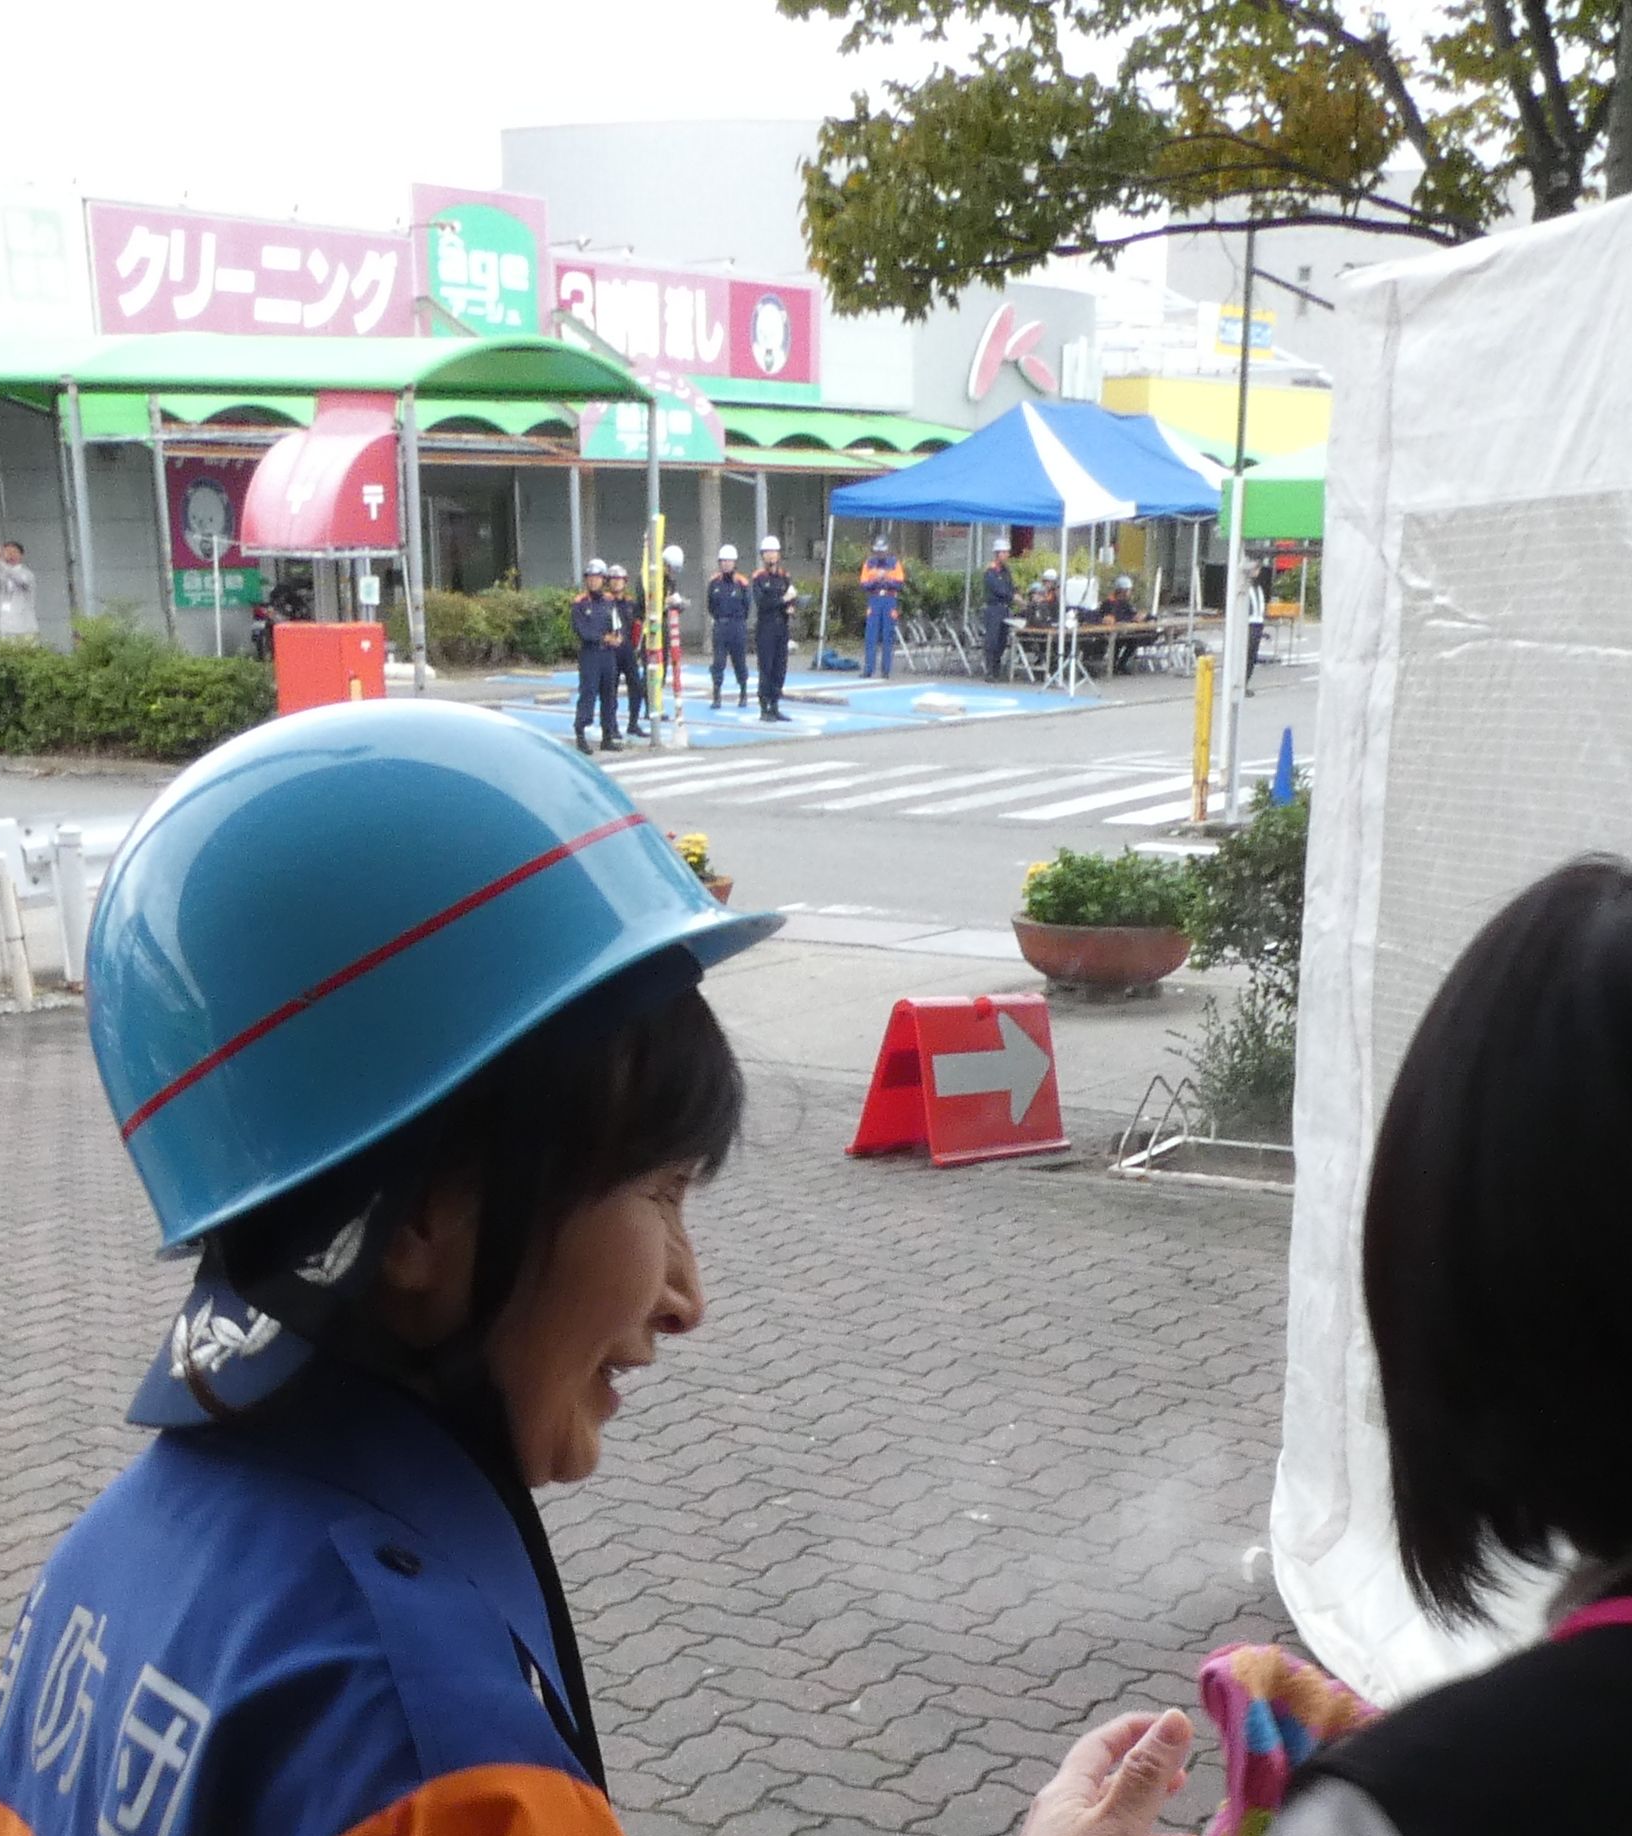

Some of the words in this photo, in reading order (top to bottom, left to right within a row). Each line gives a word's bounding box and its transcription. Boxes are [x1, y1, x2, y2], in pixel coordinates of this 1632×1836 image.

[116, 225, 398, 334] クリーニング
